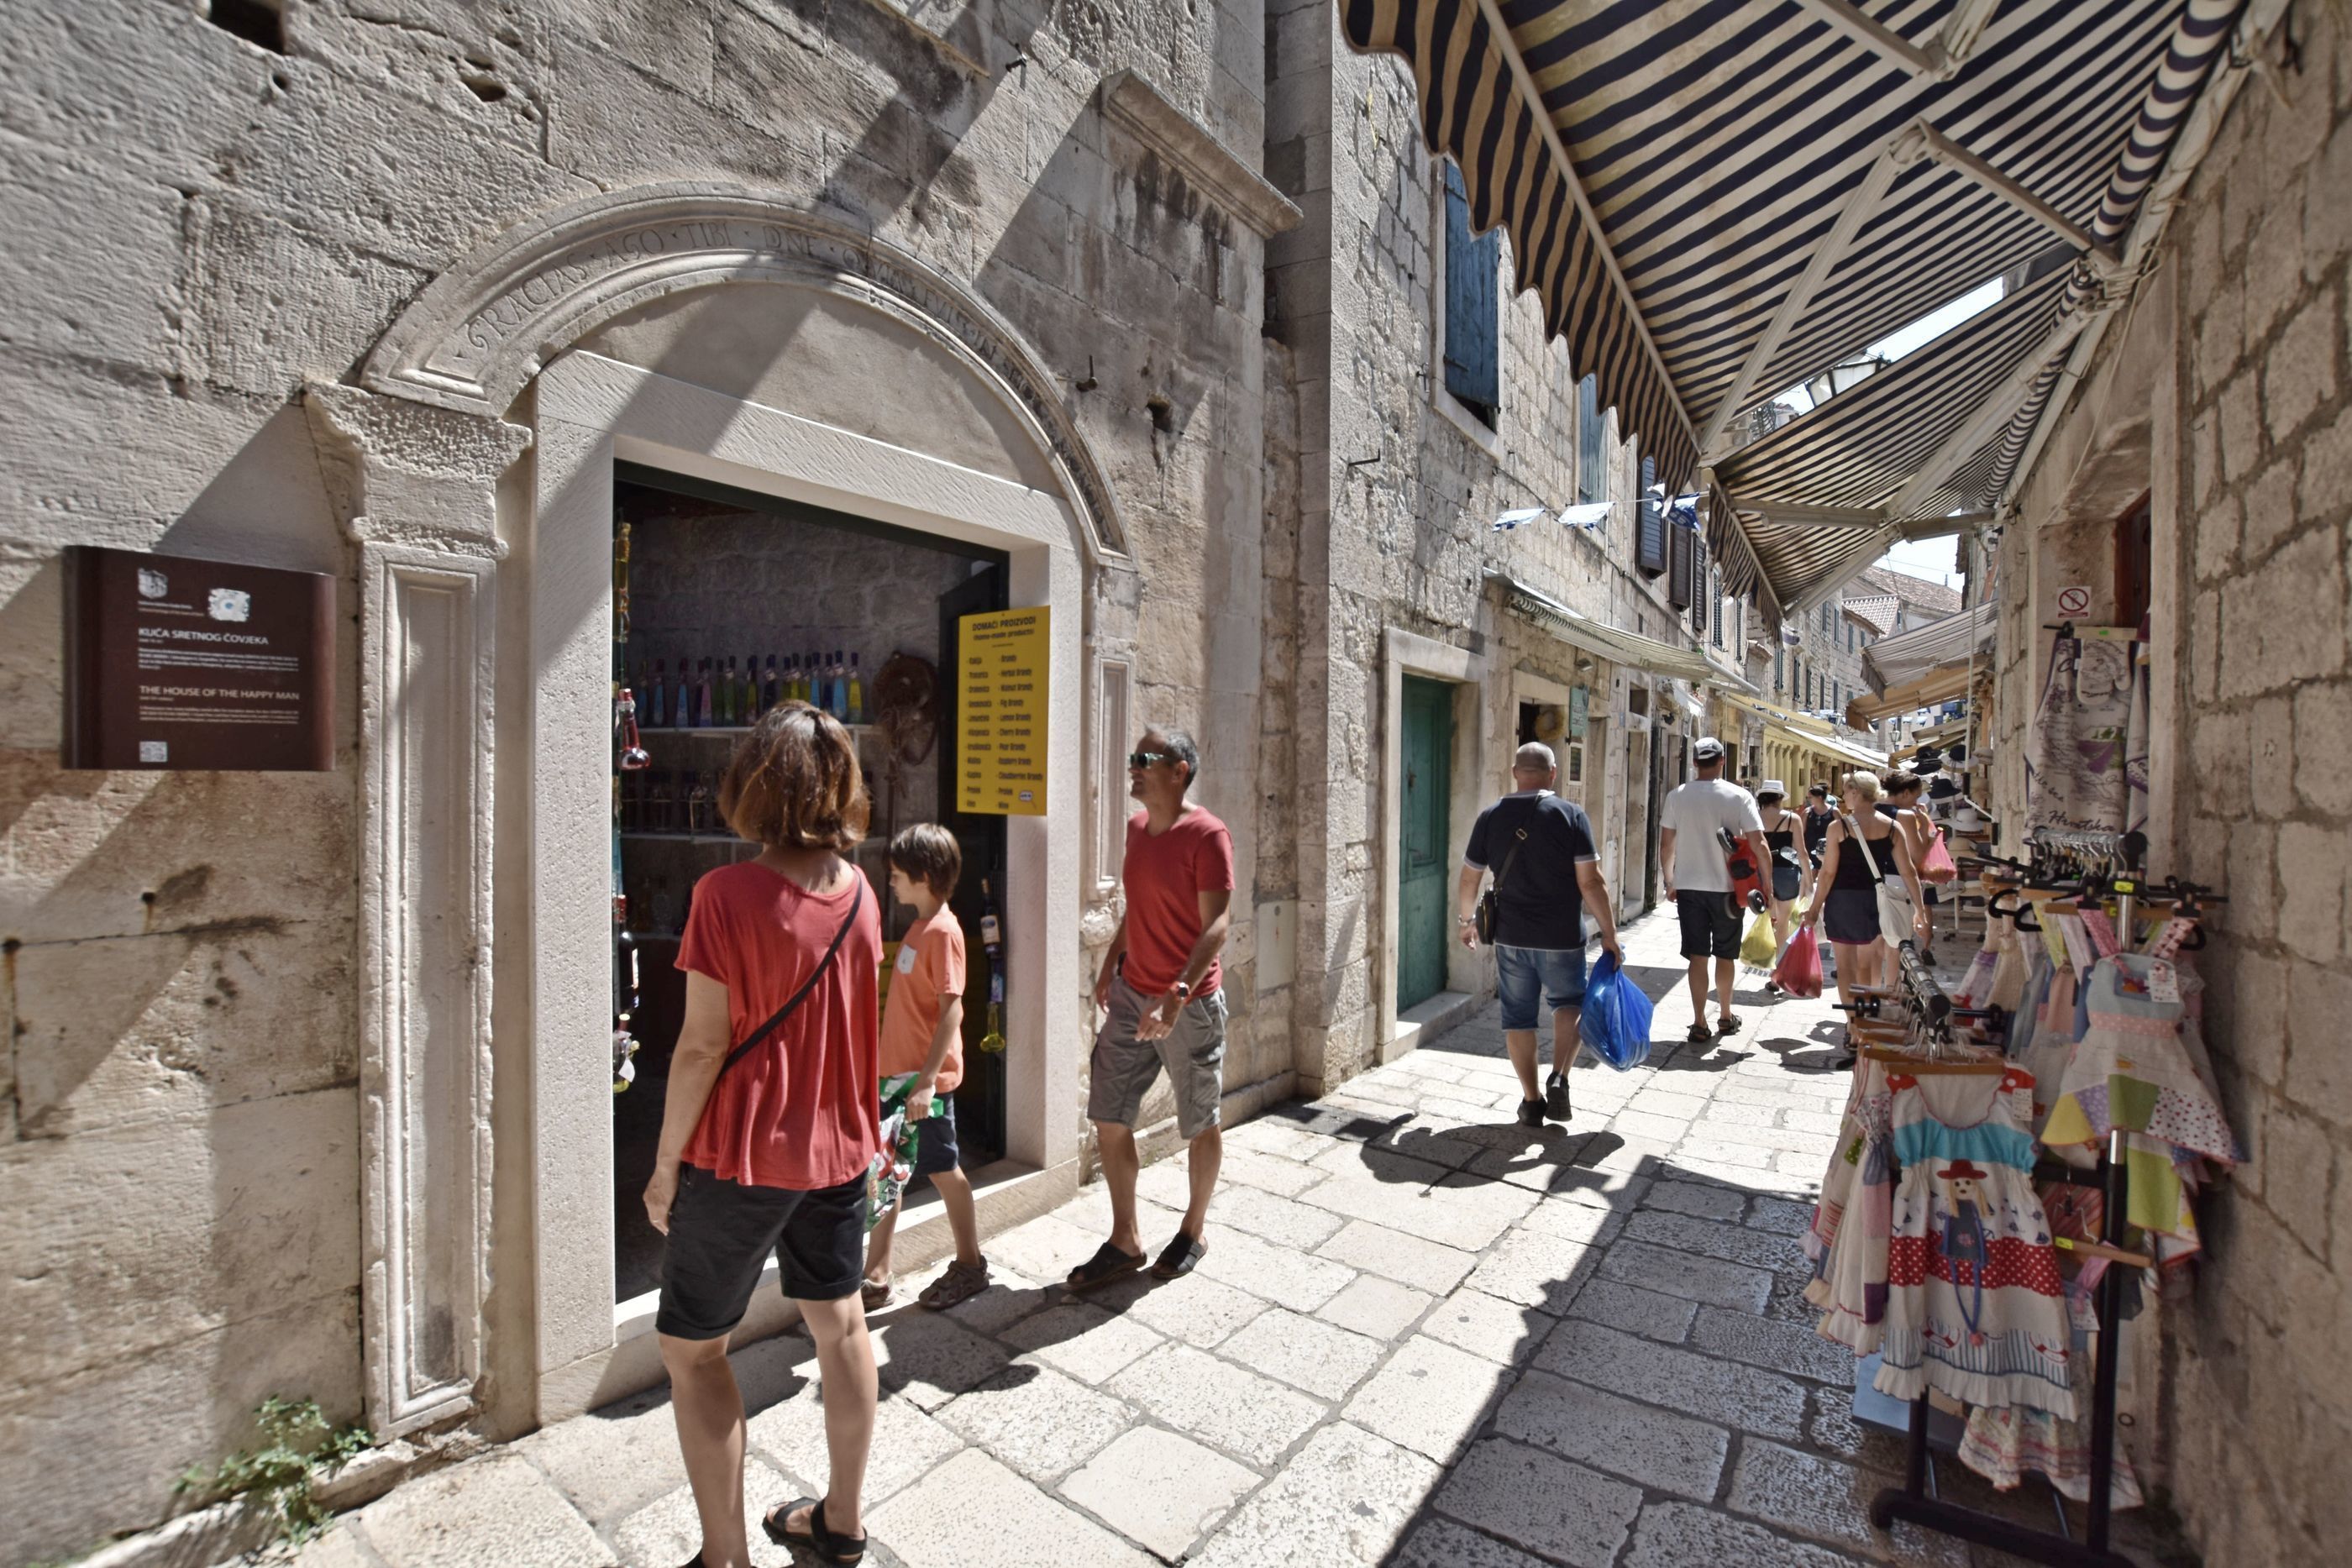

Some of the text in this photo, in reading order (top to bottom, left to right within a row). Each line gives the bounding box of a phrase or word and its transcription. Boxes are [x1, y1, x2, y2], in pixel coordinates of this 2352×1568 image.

[467, 253, 590, 352] GRACIAS
[600, 228, 666, 270] AGO
[682, 222, 732, 250] TIBI
[1000, 616, 1036, 628] PROIZVODI
[171, 630, 222, 642] SRETNOG
[223, 632, 269, 645] ČOVJEKA
[139, 684, 300, 700] THE HOUSE OF THE HAPPY MAN
